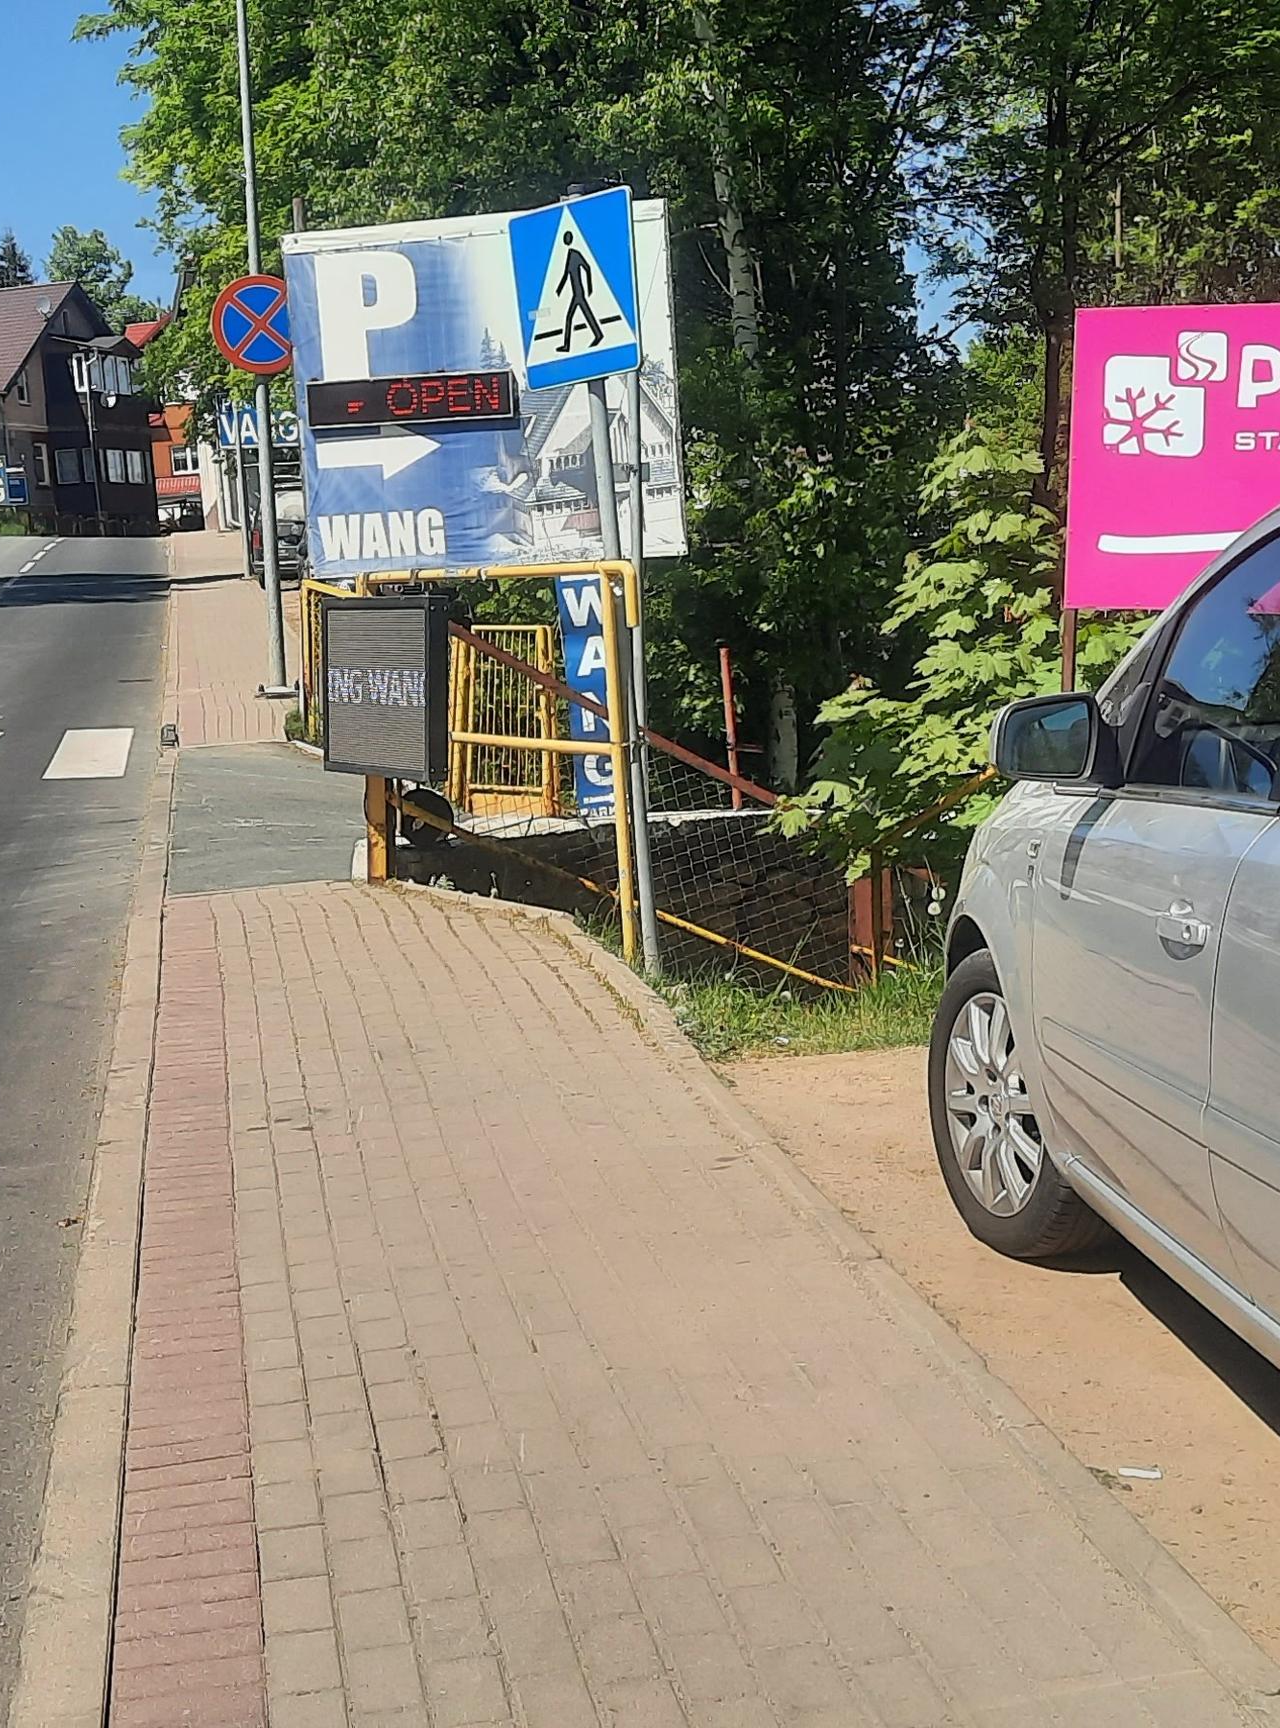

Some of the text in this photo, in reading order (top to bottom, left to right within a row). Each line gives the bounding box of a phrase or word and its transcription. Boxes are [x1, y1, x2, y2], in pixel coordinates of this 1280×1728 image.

[313, 250, 418, 382] P
[385, 375, 501, 416] OPEN
[317, 507, 446, 561] WANG
